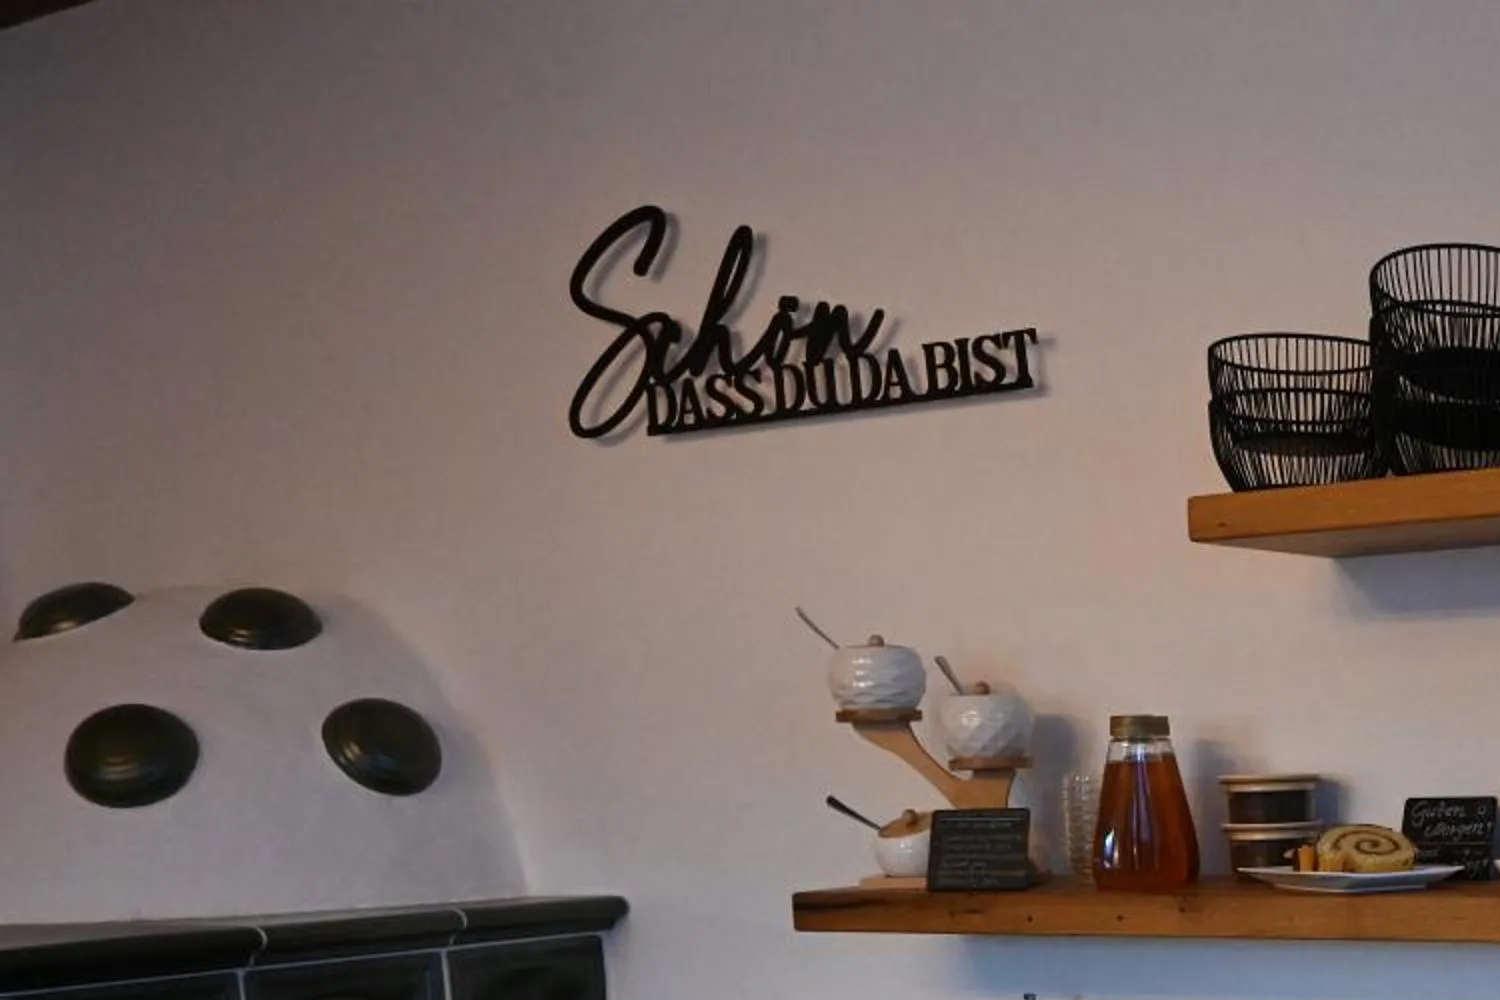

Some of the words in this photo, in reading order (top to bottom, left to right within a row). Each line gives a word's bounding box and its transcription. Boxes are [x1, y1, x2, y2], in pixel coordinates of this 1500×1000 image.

[646, 369, 765, 436] DASS
[773, 359, 838, 416] DU
[848, 347, 914, 409] DA
[921, 328, 1038, 400] BIST
